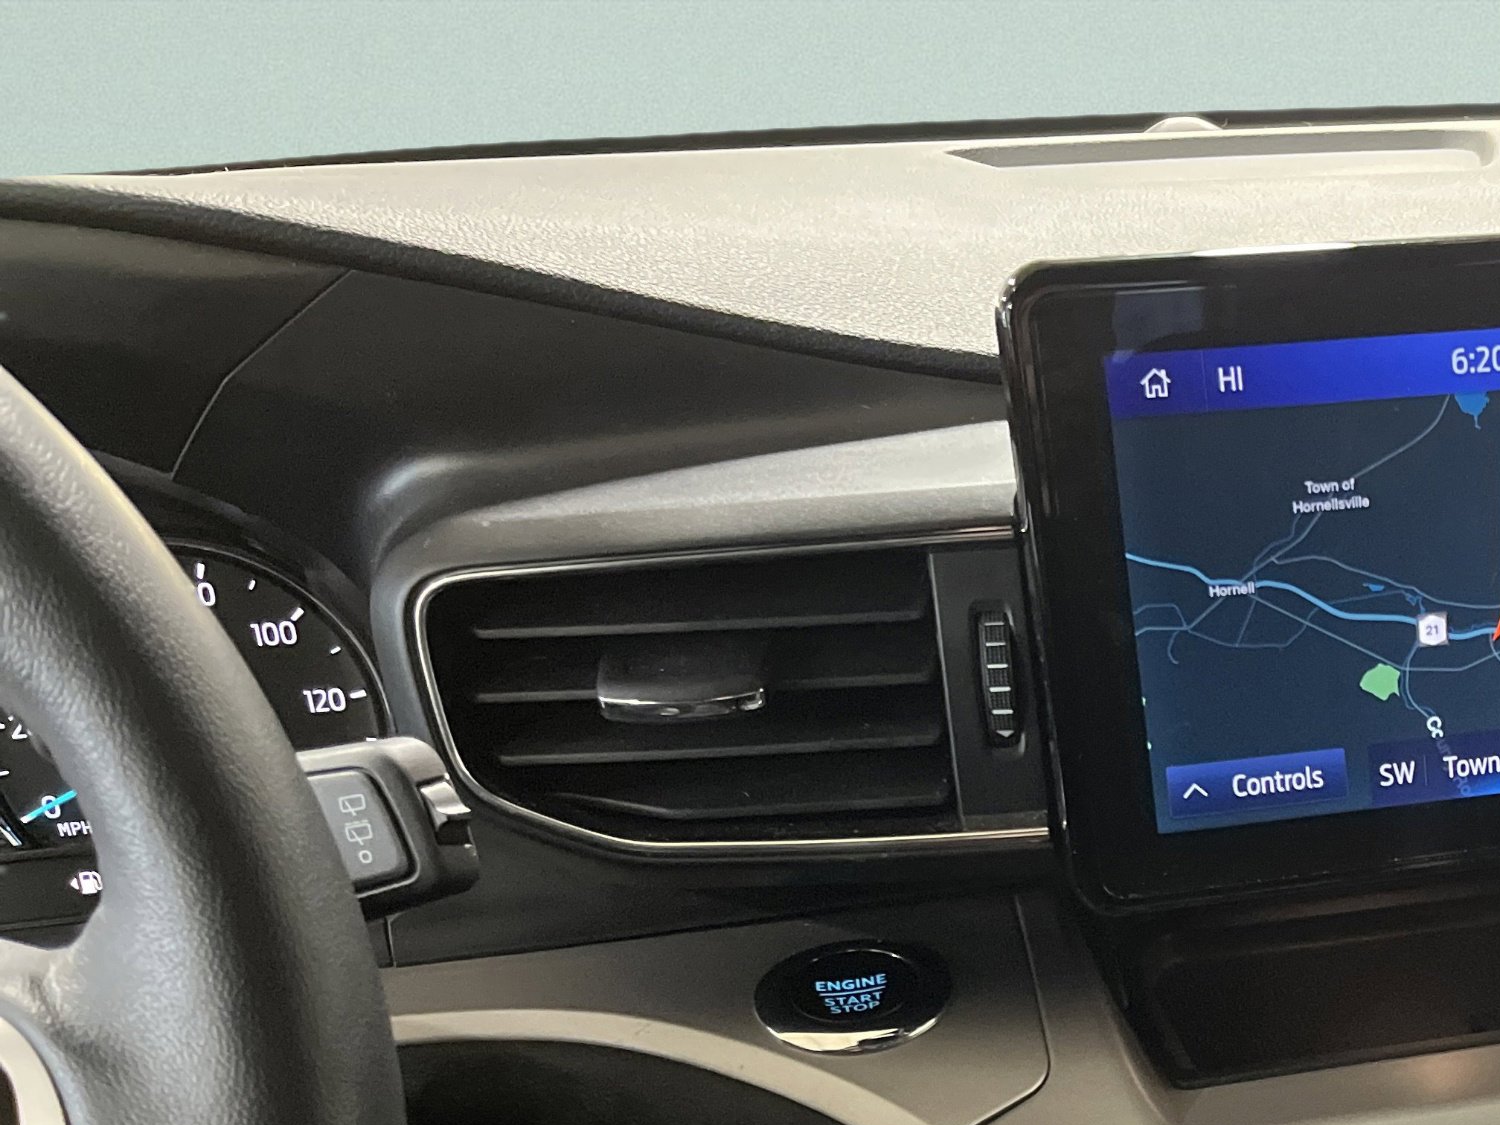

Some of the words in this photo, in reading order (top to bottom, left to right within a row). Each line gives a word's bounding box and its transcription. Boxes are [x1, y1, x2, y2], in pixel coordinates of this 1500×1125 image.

[1217, 365, 1243, 393] HI
[1304, 480, 1340, 494] Town
[1341, 477, 1355, 491] of
[1292, 495, 1370, 514] Hornellsville
[196, 581, 216, 608] 0
[1208, 581, 1256, 598] Hornell
[249, 618, 298, 647] 100
[1425, 624, 1439, 636] 21
[302, 687, 346, 714] 120
[1379, 760, 1416, 787] SW
[1442, 755, 1500, 779] Town
[1232, 765, 1324, 798] Controls
[55, 819, 95, 838] MPH
[815, 973, 888, 992] ENGINE
[824, 991, 883, 1007] START
[830, 1000, 881, 1014] STOP
